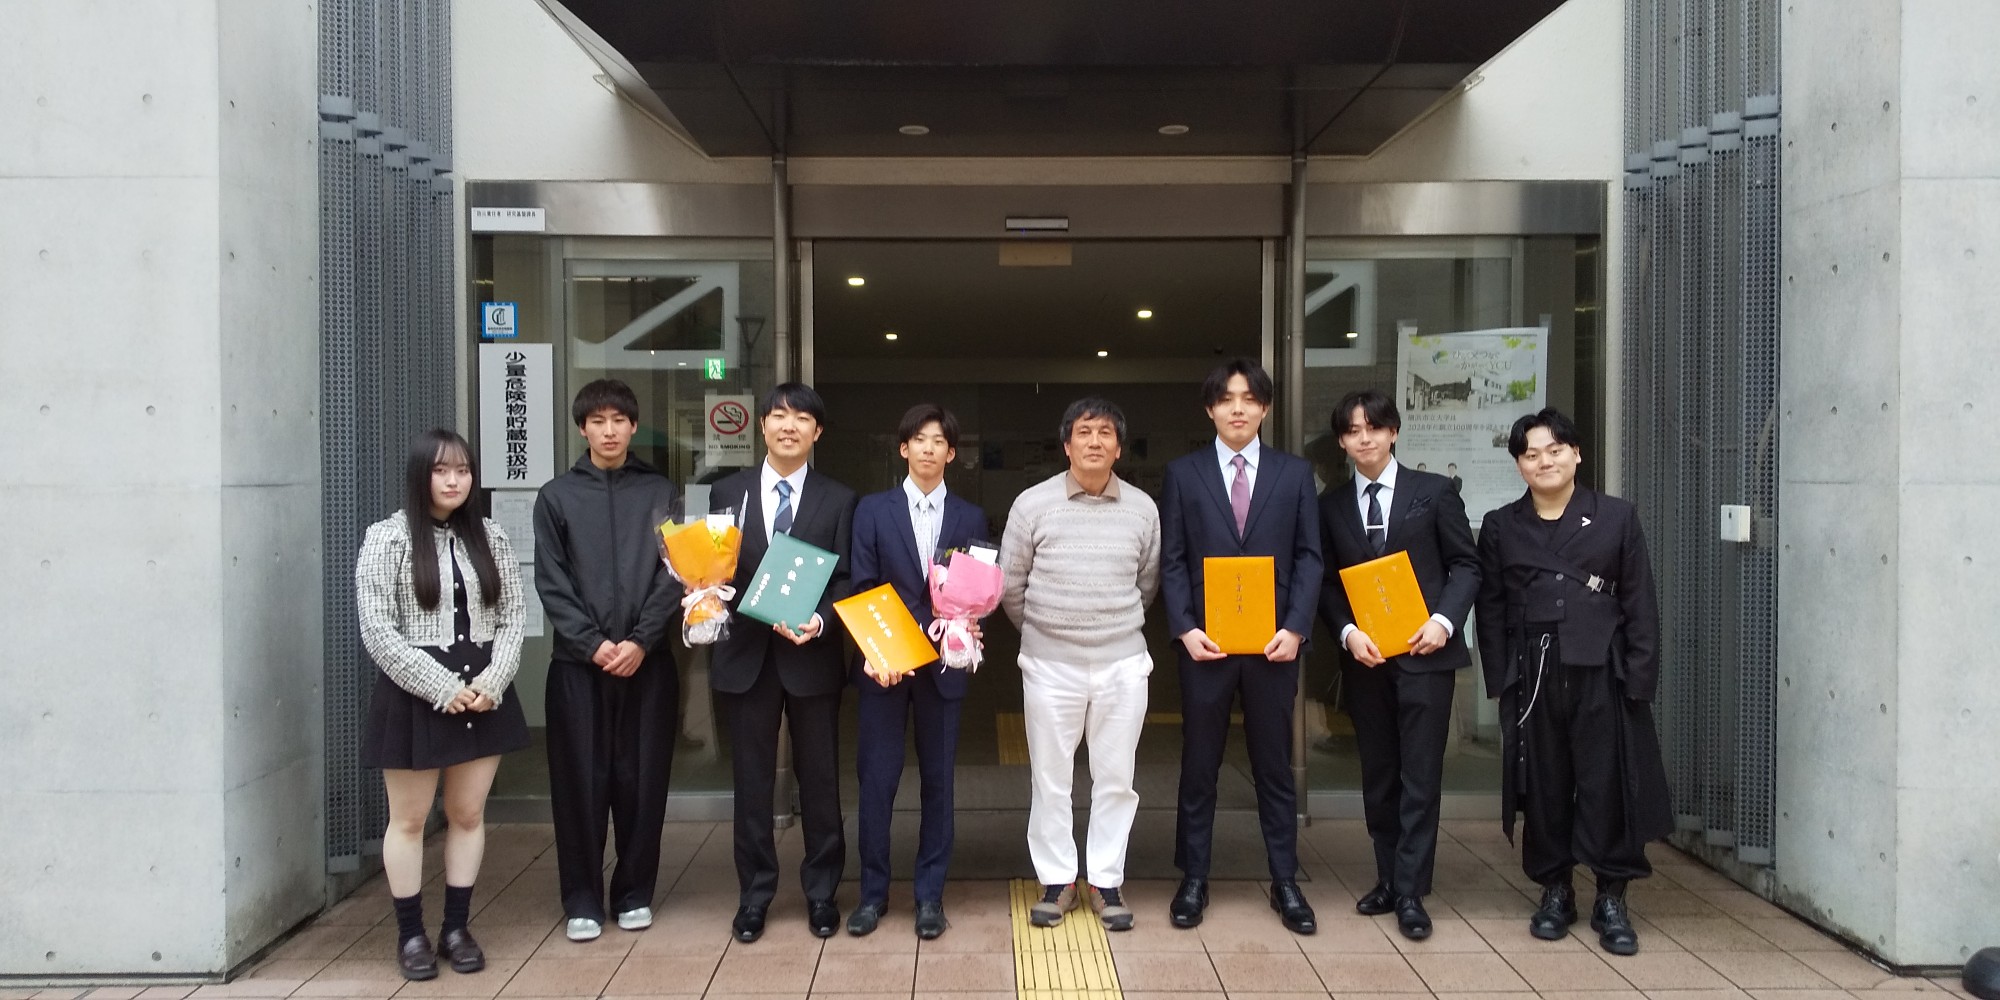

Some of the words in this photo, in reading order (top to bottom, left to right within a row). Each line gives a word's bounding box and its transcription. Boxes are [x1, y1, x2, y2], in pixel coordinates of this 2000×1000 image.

[505, 351, 527, 480] 少量危険物貯蔵取扱所
